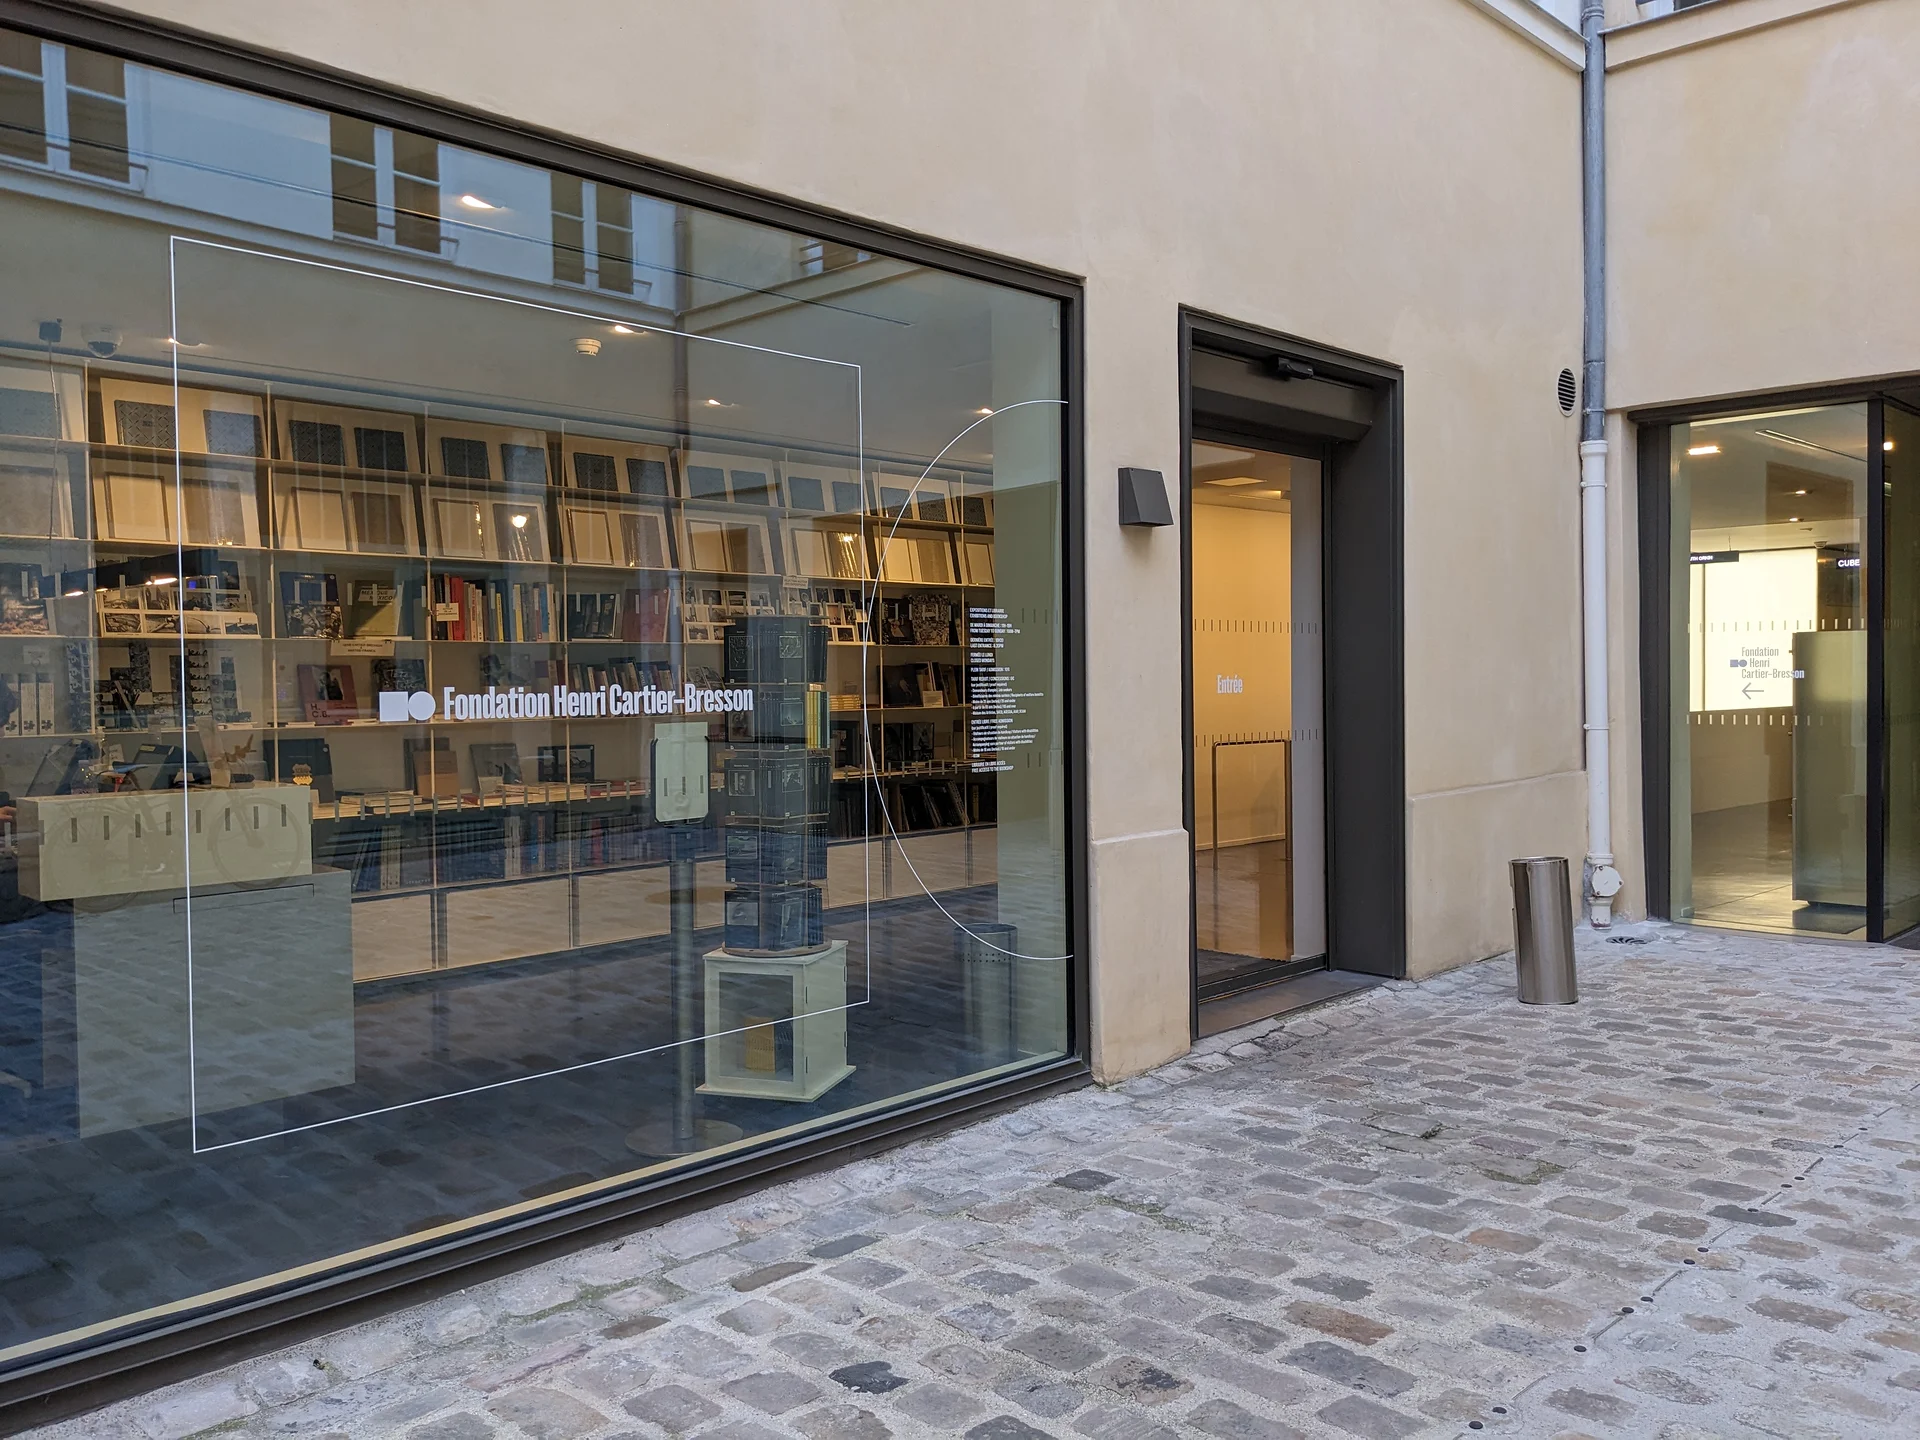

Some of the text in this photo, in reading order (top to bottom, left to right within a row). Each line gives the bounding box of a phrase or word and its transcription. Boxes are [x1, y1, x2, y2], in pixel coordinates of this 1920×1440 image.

[1838, 559, 1860, 568] CUBE
[1741, 646, 1779, 657] Fondation
[1749, 658, 1770, 667] Henri
[1741, 668, 1805, 679] Cartier-Bresson
[1217, 674, 1243, 694] Entrée
[444, 683, 754, 720] Fondation Henri Cartier-Bresson
